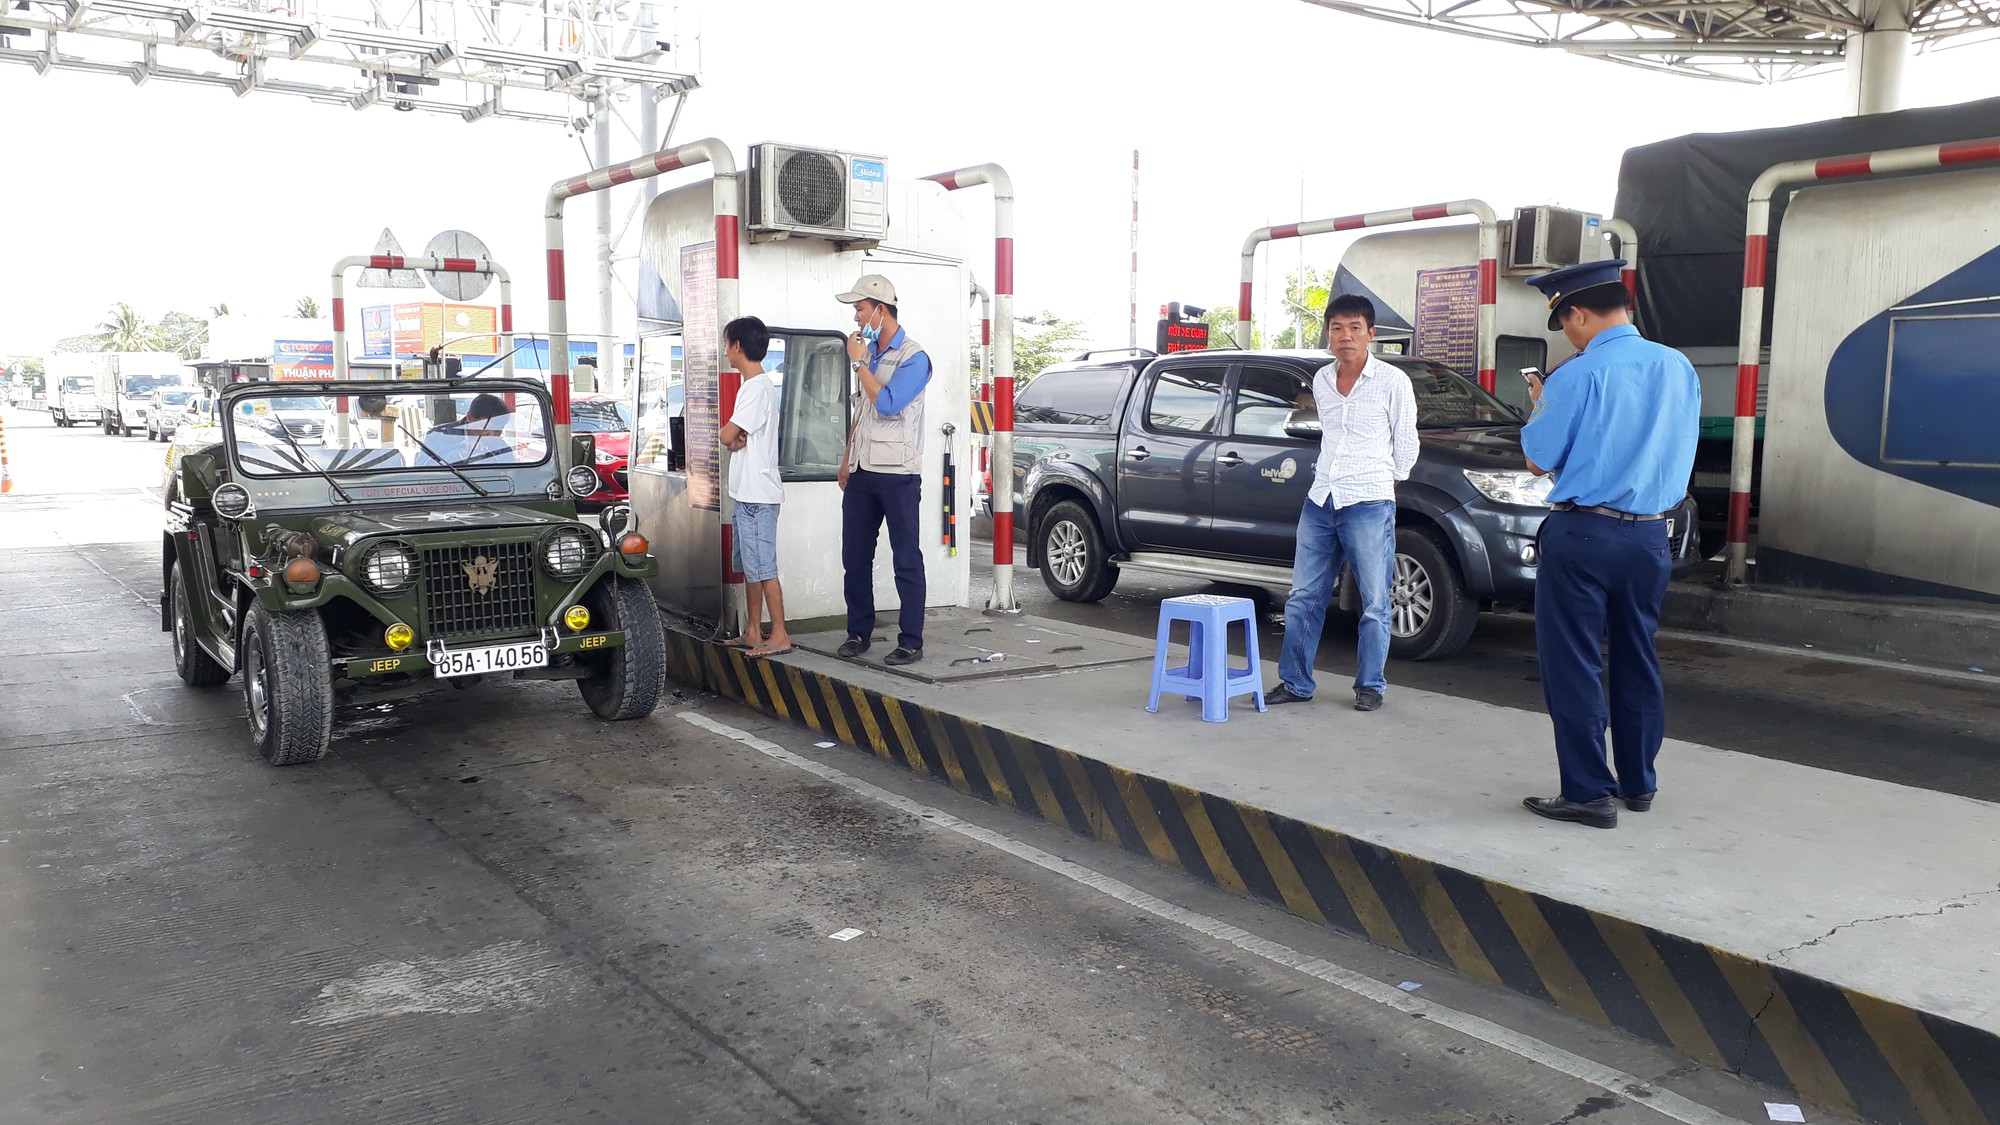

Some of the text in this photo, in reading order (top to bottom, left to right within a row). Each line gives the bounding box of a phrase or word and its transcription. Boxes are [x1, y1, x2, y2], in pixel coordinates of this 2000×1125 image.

[1181, 327, 1191, 337] XE
[282, 366, 317, 380] THUẬN
[361, 489, 380, 497] FOR
[384, 487, 420, 497] OFFCIAL
[579, 636, 606, 649] JEEP
[369, 659, 401, 673] JEEP
